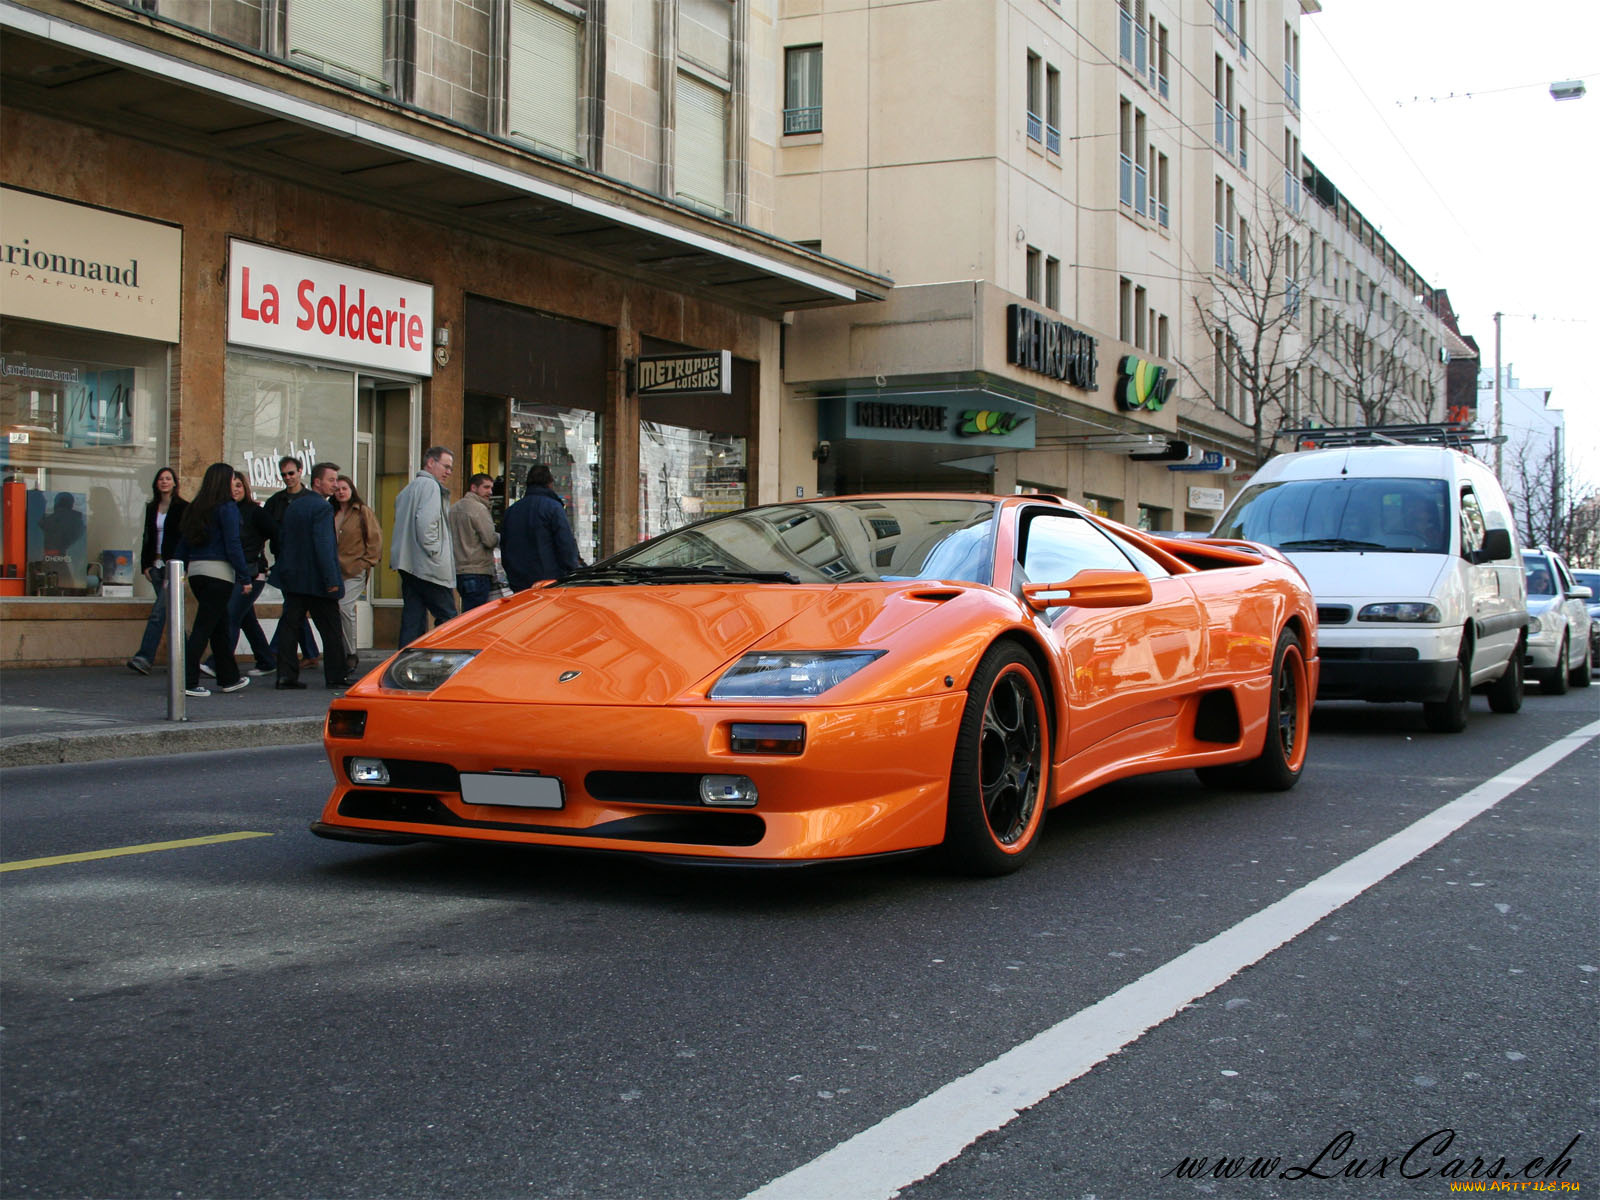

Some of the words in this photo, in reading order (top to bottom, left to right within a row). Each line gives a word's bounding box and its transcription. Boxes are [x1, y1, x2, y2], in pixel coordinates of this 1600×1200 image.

[241, 266, 280, 325] La
[296, 279, 424, 351] Solderie
[1006, 303, 1099, 392] METROPOLE
[640, 357, 719, 389] METROPOLE
[676, 368, 719, 389] LOISIRS
[856, 401, 948, 432] METROPOLE
[243, 447, 285, 487] Tout
